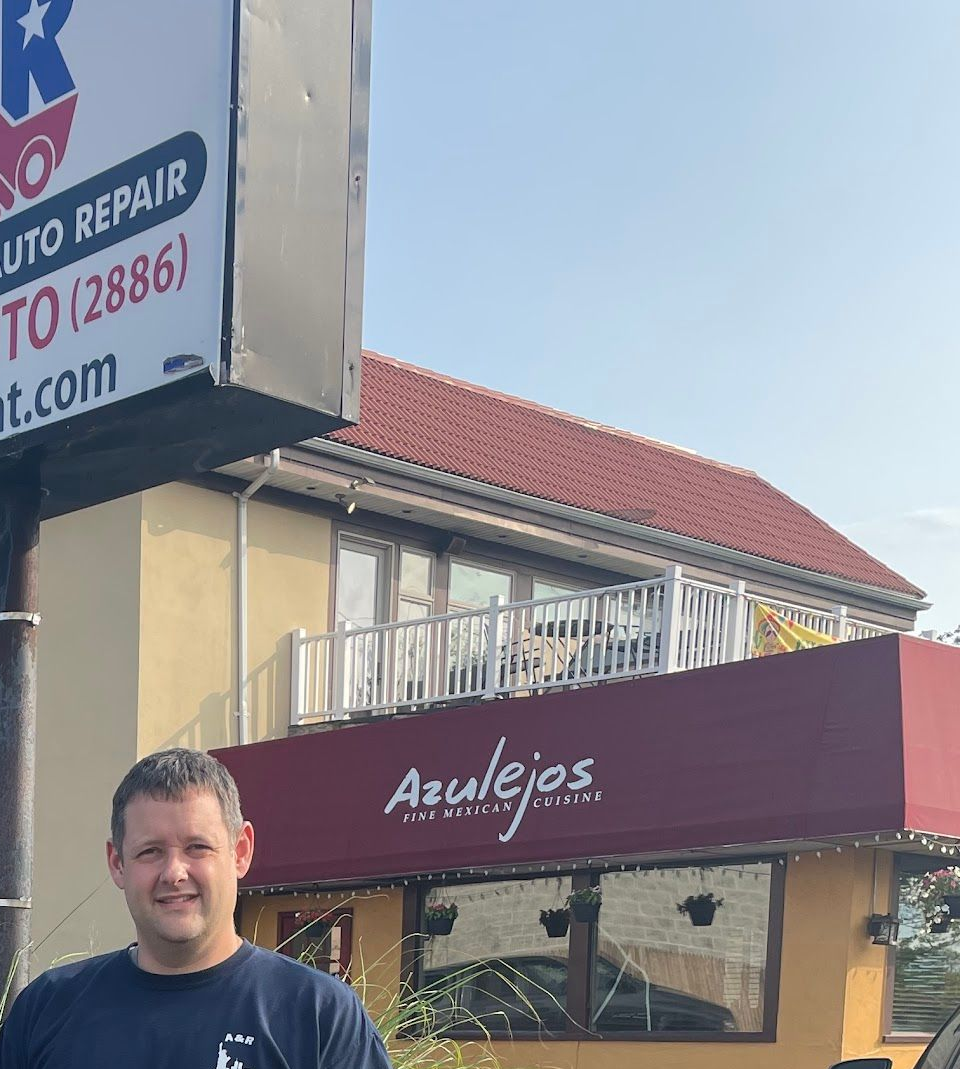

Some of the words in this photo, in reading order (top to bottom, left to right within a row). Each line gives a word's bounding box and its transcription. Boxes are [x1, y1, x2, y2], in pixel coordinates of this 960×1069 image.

[75, 158, 188, 244] REPAIR
[70, 232, 188, 333] (2886)
[384, 736, 595, 843] Azulejos
[403, 810, 437, 823] FINE
[442, 801, 513, 819] MEXICAN
[533, 790, 604, 809] CUISINE
